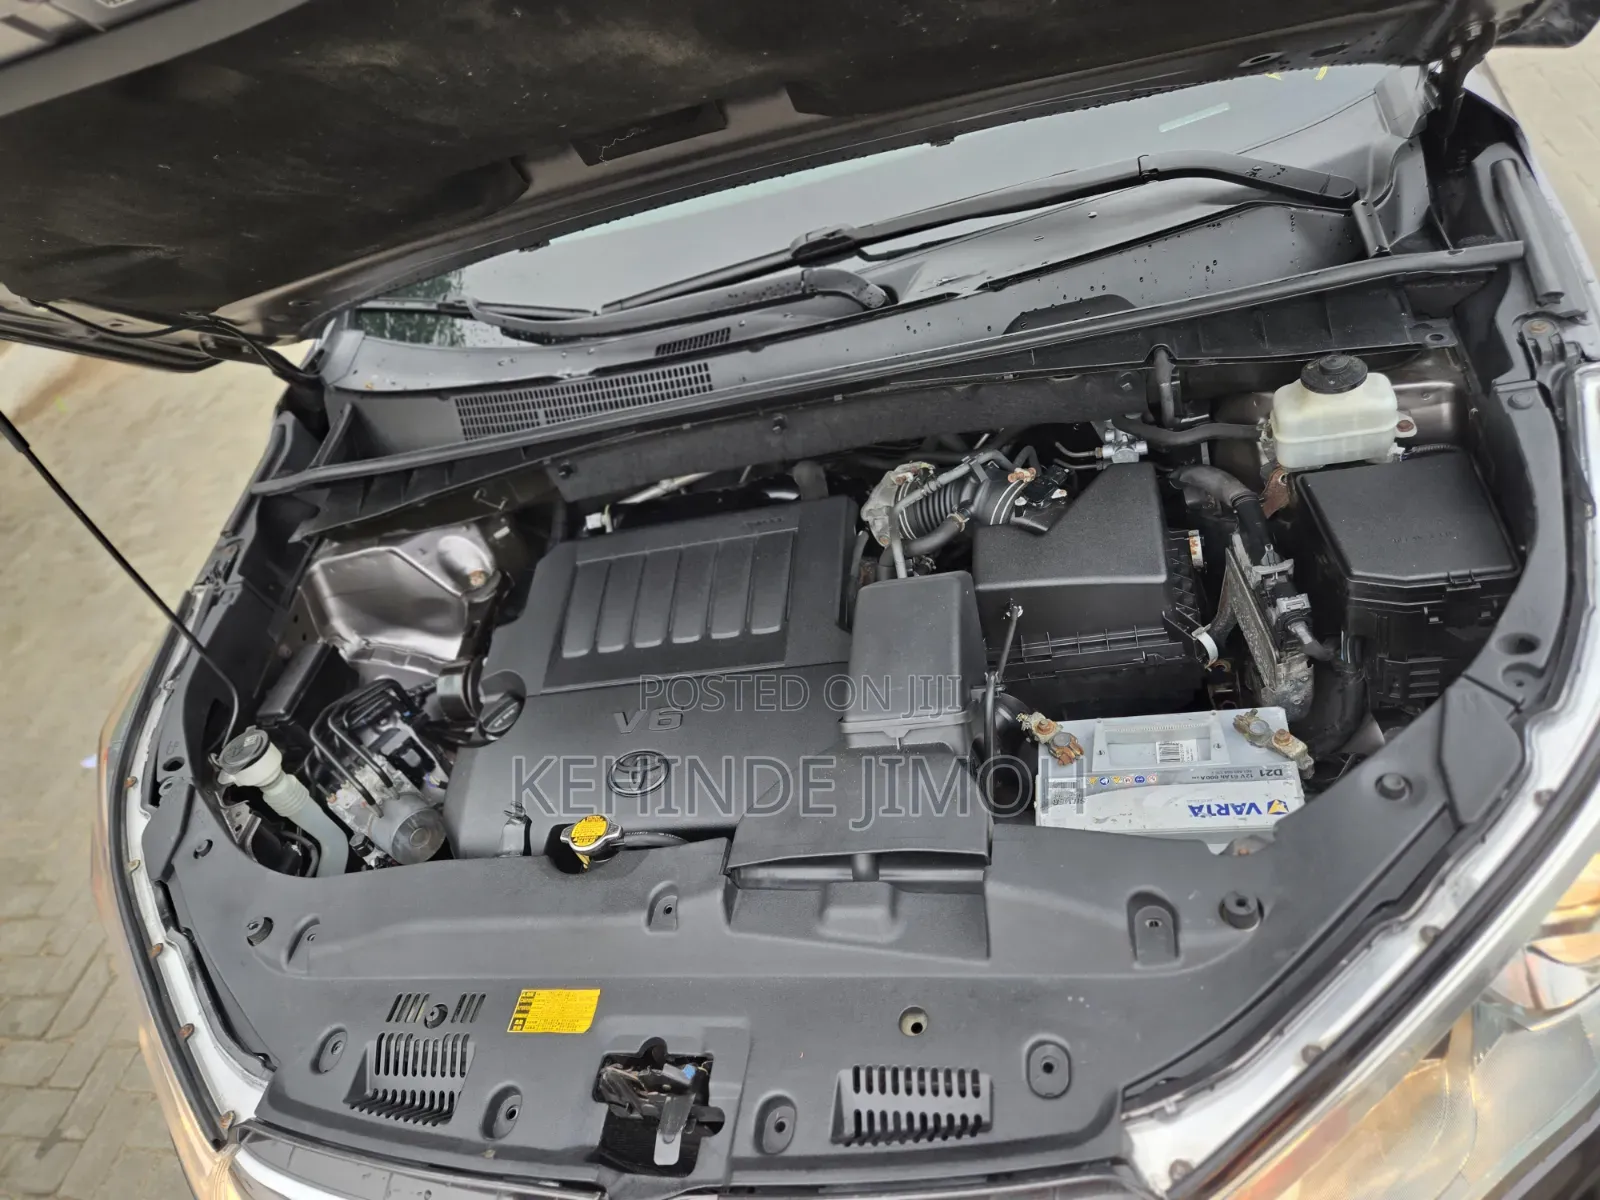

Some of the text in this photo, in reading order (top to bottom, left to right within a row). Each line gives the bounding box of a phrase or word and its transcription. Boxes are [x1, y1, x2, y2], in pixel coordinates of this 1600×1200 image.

[613, 706, 684, 734] V6
[1259, 769, 1283, 777] D21
[1188, 802, 1263, 818] VARTA
